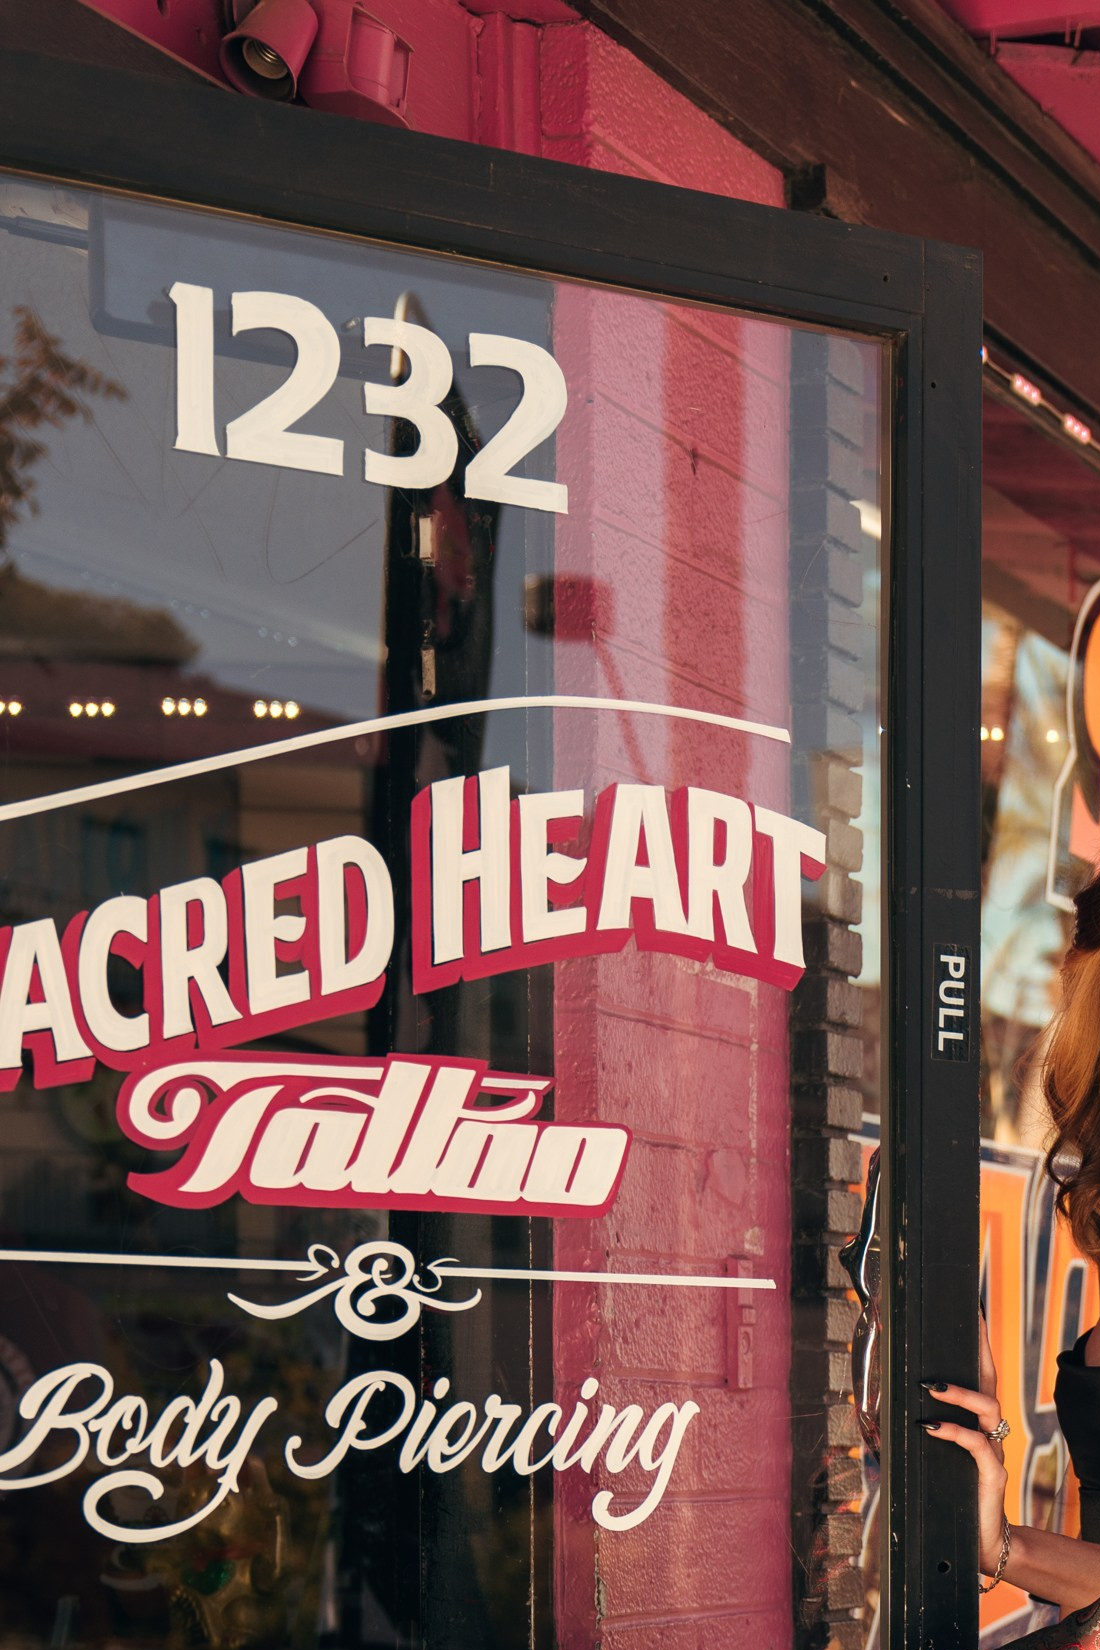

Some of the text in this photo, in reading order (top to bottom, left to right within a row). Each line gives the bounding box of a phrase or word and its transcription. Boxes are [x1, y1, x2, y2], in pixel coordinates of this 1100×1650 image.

[168, 281, 570, 516] 1232
[0, 765, 828, 1076] ACRED HEART
[938, 954, 966, 1051] PULL
[127, 1060, 628, 1206] Tattoo
[0, 1358, 701, 1543] Body Piercing
